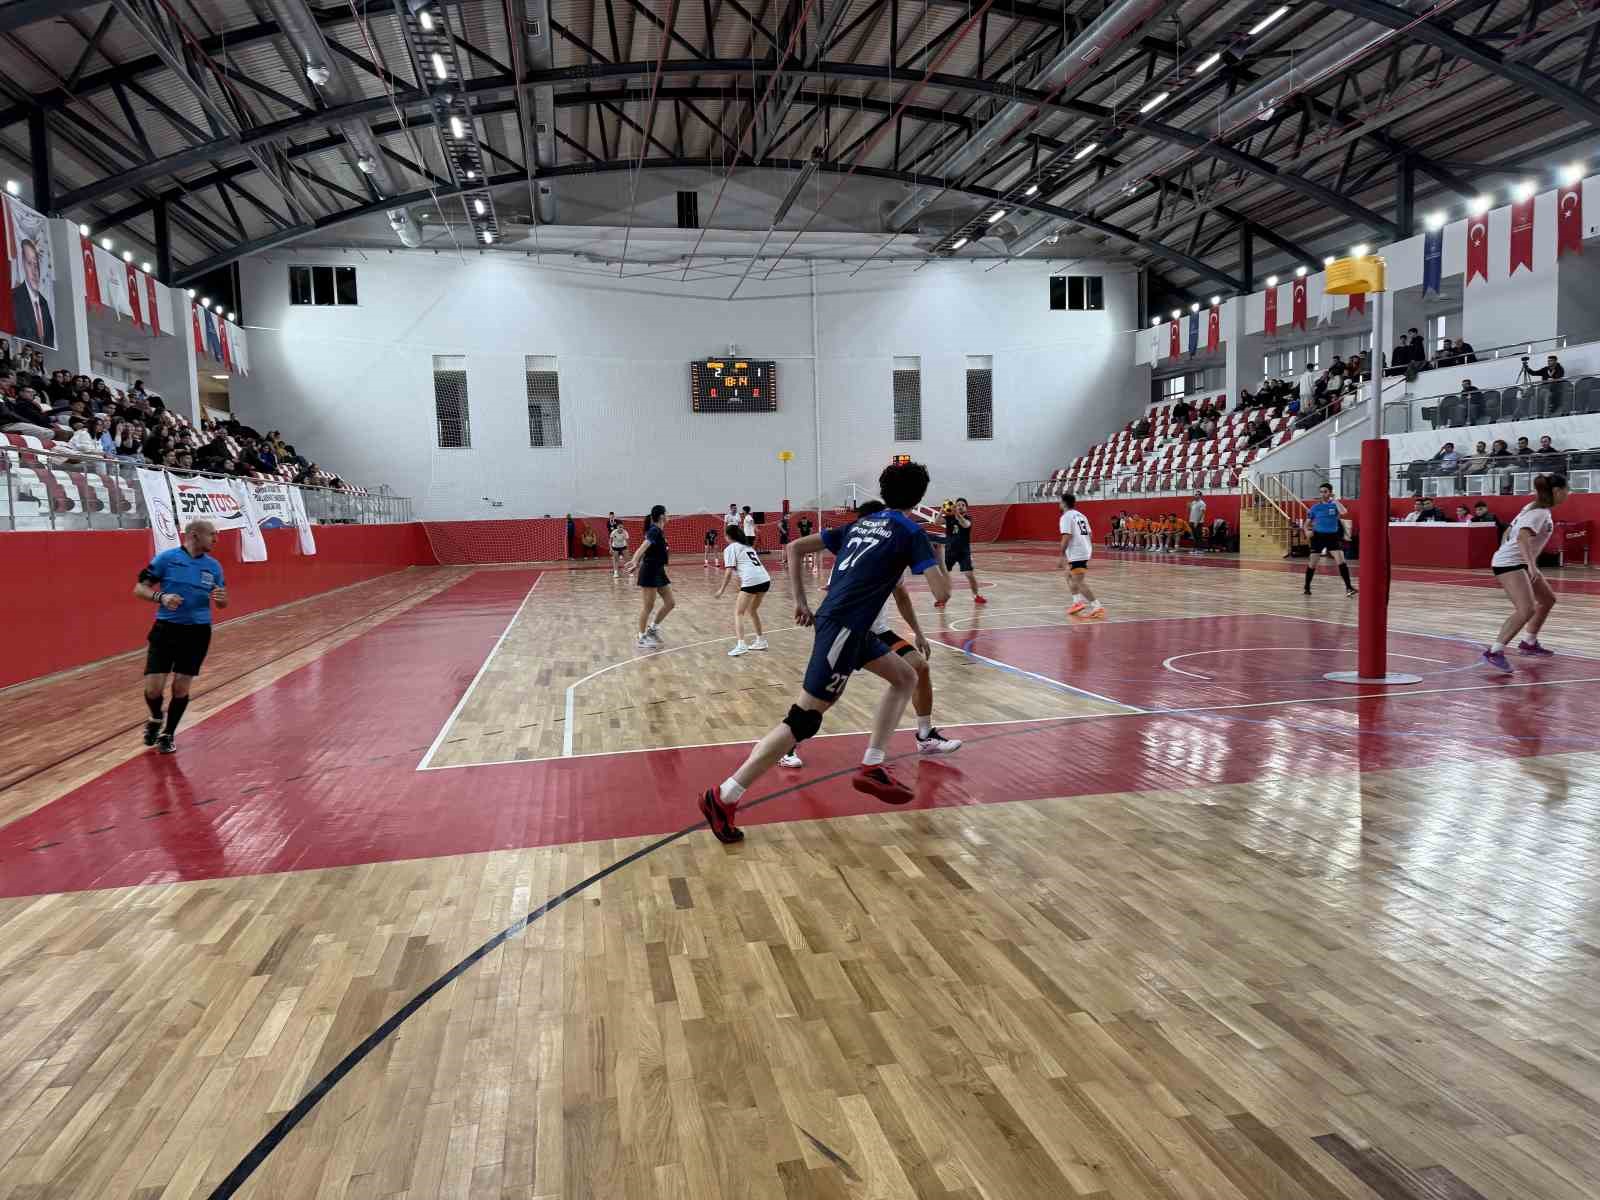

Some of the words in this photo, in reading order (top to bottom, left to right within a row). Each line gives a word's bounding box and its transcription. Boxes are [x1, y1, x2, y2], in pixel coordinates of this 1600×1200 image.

[714, 367, 721, 378] 2
[746, 551, 761, 567] 5
[838, 536, 879, 571] 27
[825, 673, 848, 692] 27
